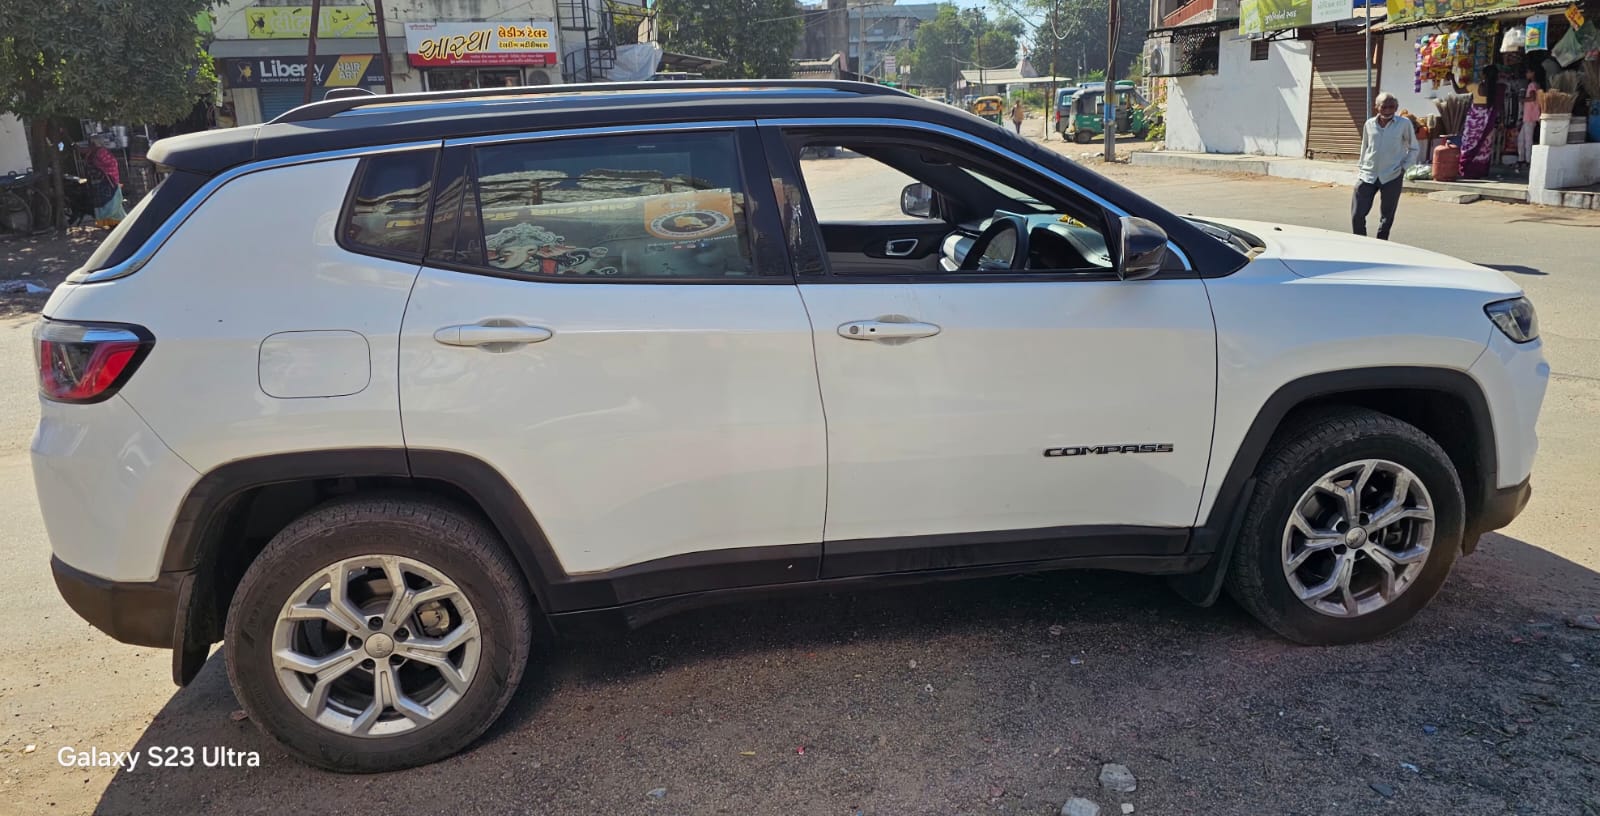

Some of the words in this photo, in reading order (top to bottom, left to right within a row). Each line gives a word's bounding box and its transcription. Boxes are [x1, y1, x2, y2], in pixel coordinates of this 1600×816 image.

[498, 26, 525, 38] લેડીઝ
[527, 26, 548, 38] ટેલર
[259, 59, 325, 82] Libery
[338, 62, 361, 72] HAIR
[339, 71, 359, 80] ART
[1043, 443, 1174, 457] COMPASS
